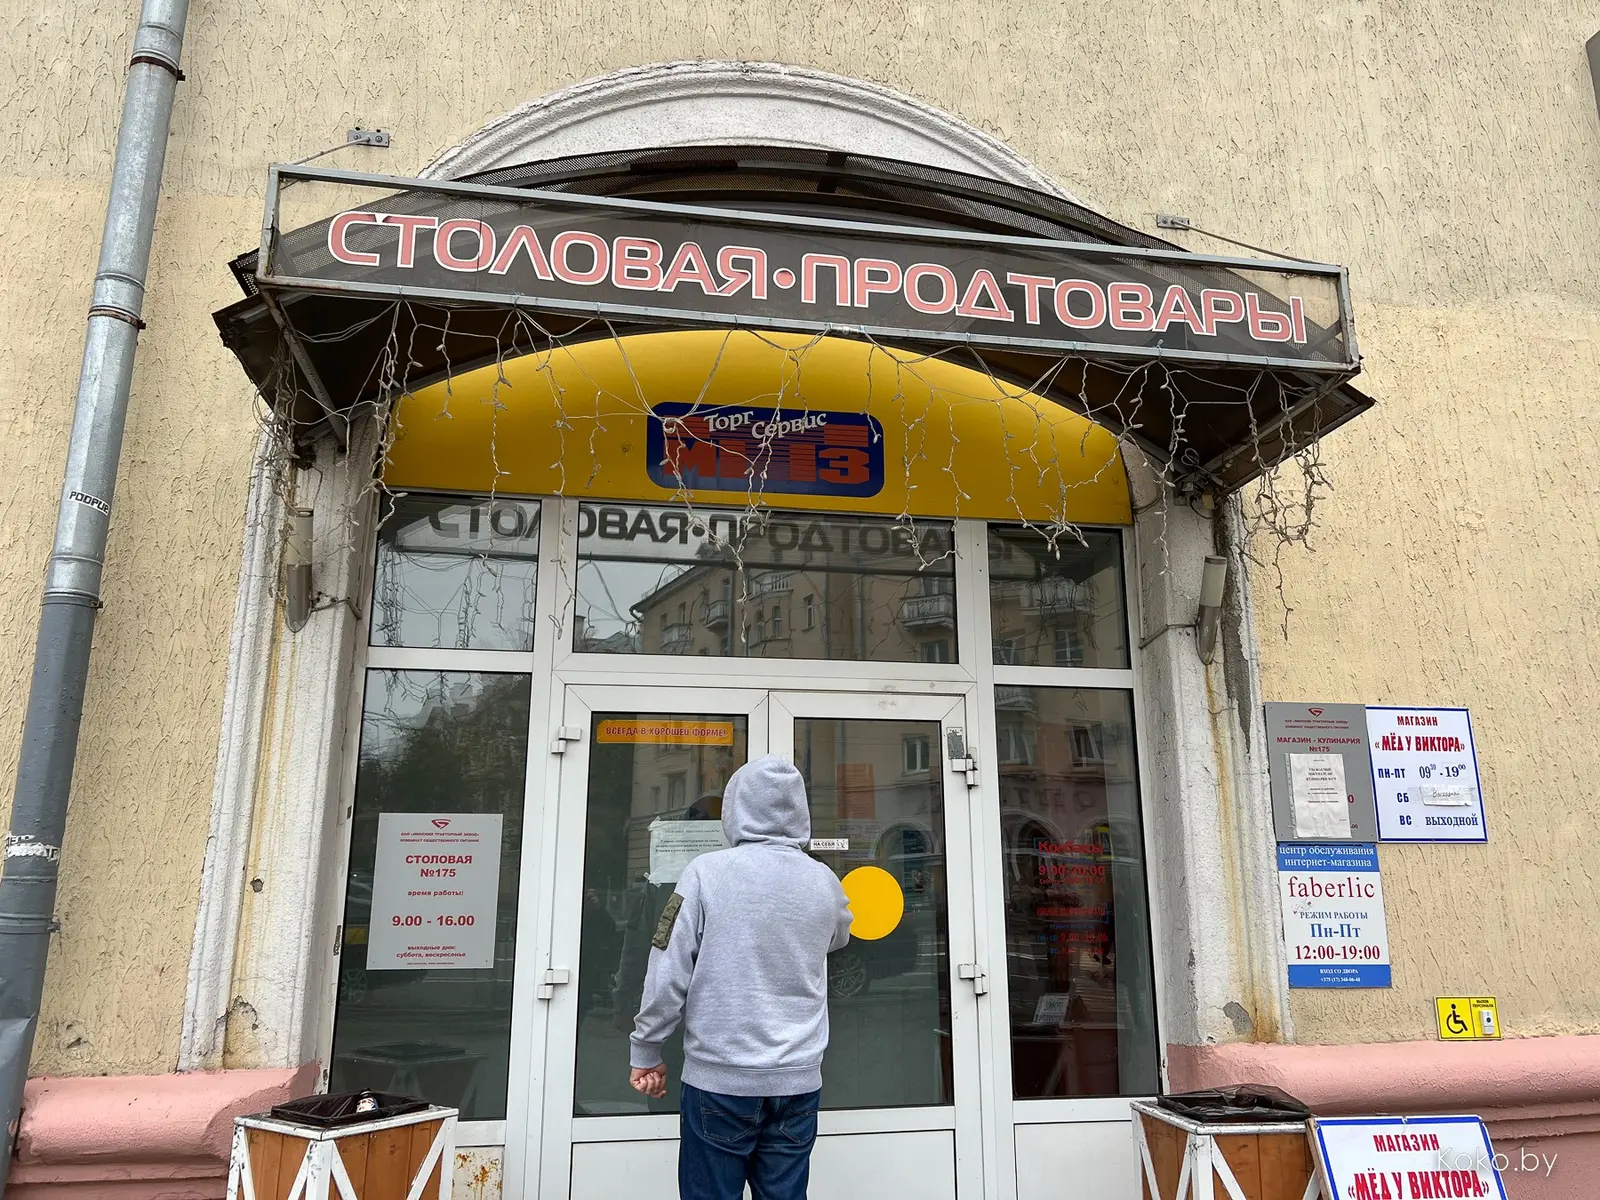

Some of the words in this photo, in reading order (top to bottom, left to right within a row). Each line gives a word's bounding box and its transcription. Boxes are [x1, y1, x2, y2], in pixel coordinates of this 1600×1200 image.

[327, 211, 768, 299] СТОЛОВАЯ
[801, 253, 1308, 344] ПРОДТОВАРЫ
[704, 411, 754, 432] Торг
[751, 413, 828, 439] Сервис
[1397, 716, 1438, 726] МАГАЗИН
[606, 727, 639, 736] ВСЕГДА
[1317, 737, 1361, 745] КУЛИНАРИЯ
[1405, 735, 1412, 751] У
[1378, 768, 1405, 778] ПН-ПТ
[1397, 793, 1409, 803] СБ
[1399, 815, 1412, 825] ВС
[1425, 813, 1479, 827] ВЫХОДНОЙ
[1279, 846, 1308, 856] центр
[1309, 845, 1374, 856] обслуживания
[405, 855, 473, 864] СТОЛОВАЯ
[1284, 858, 1372, 869] интернет-магазина
[420, 868, 457, 877] №175
[1288, 876, 1375, 898] faberlic
[392, 915, 422, 926] 9.00
[437, 915, 475, 926] 16.00
[1300, 911, 1332, 919] РЕЖИМ
[1334, 911, 1368, 919] РАБОТЫ
[1310, 923, 1360, 938] Пн-Пт
[1295, 945, 1381, 960] 12:00-19:00
[1373, 1134, 1440, 1153] МАГАЗИН
[1391, 1172, 1403, 1200] У
[1408, 1170, 1490, 1200] ВИКТОРА»
